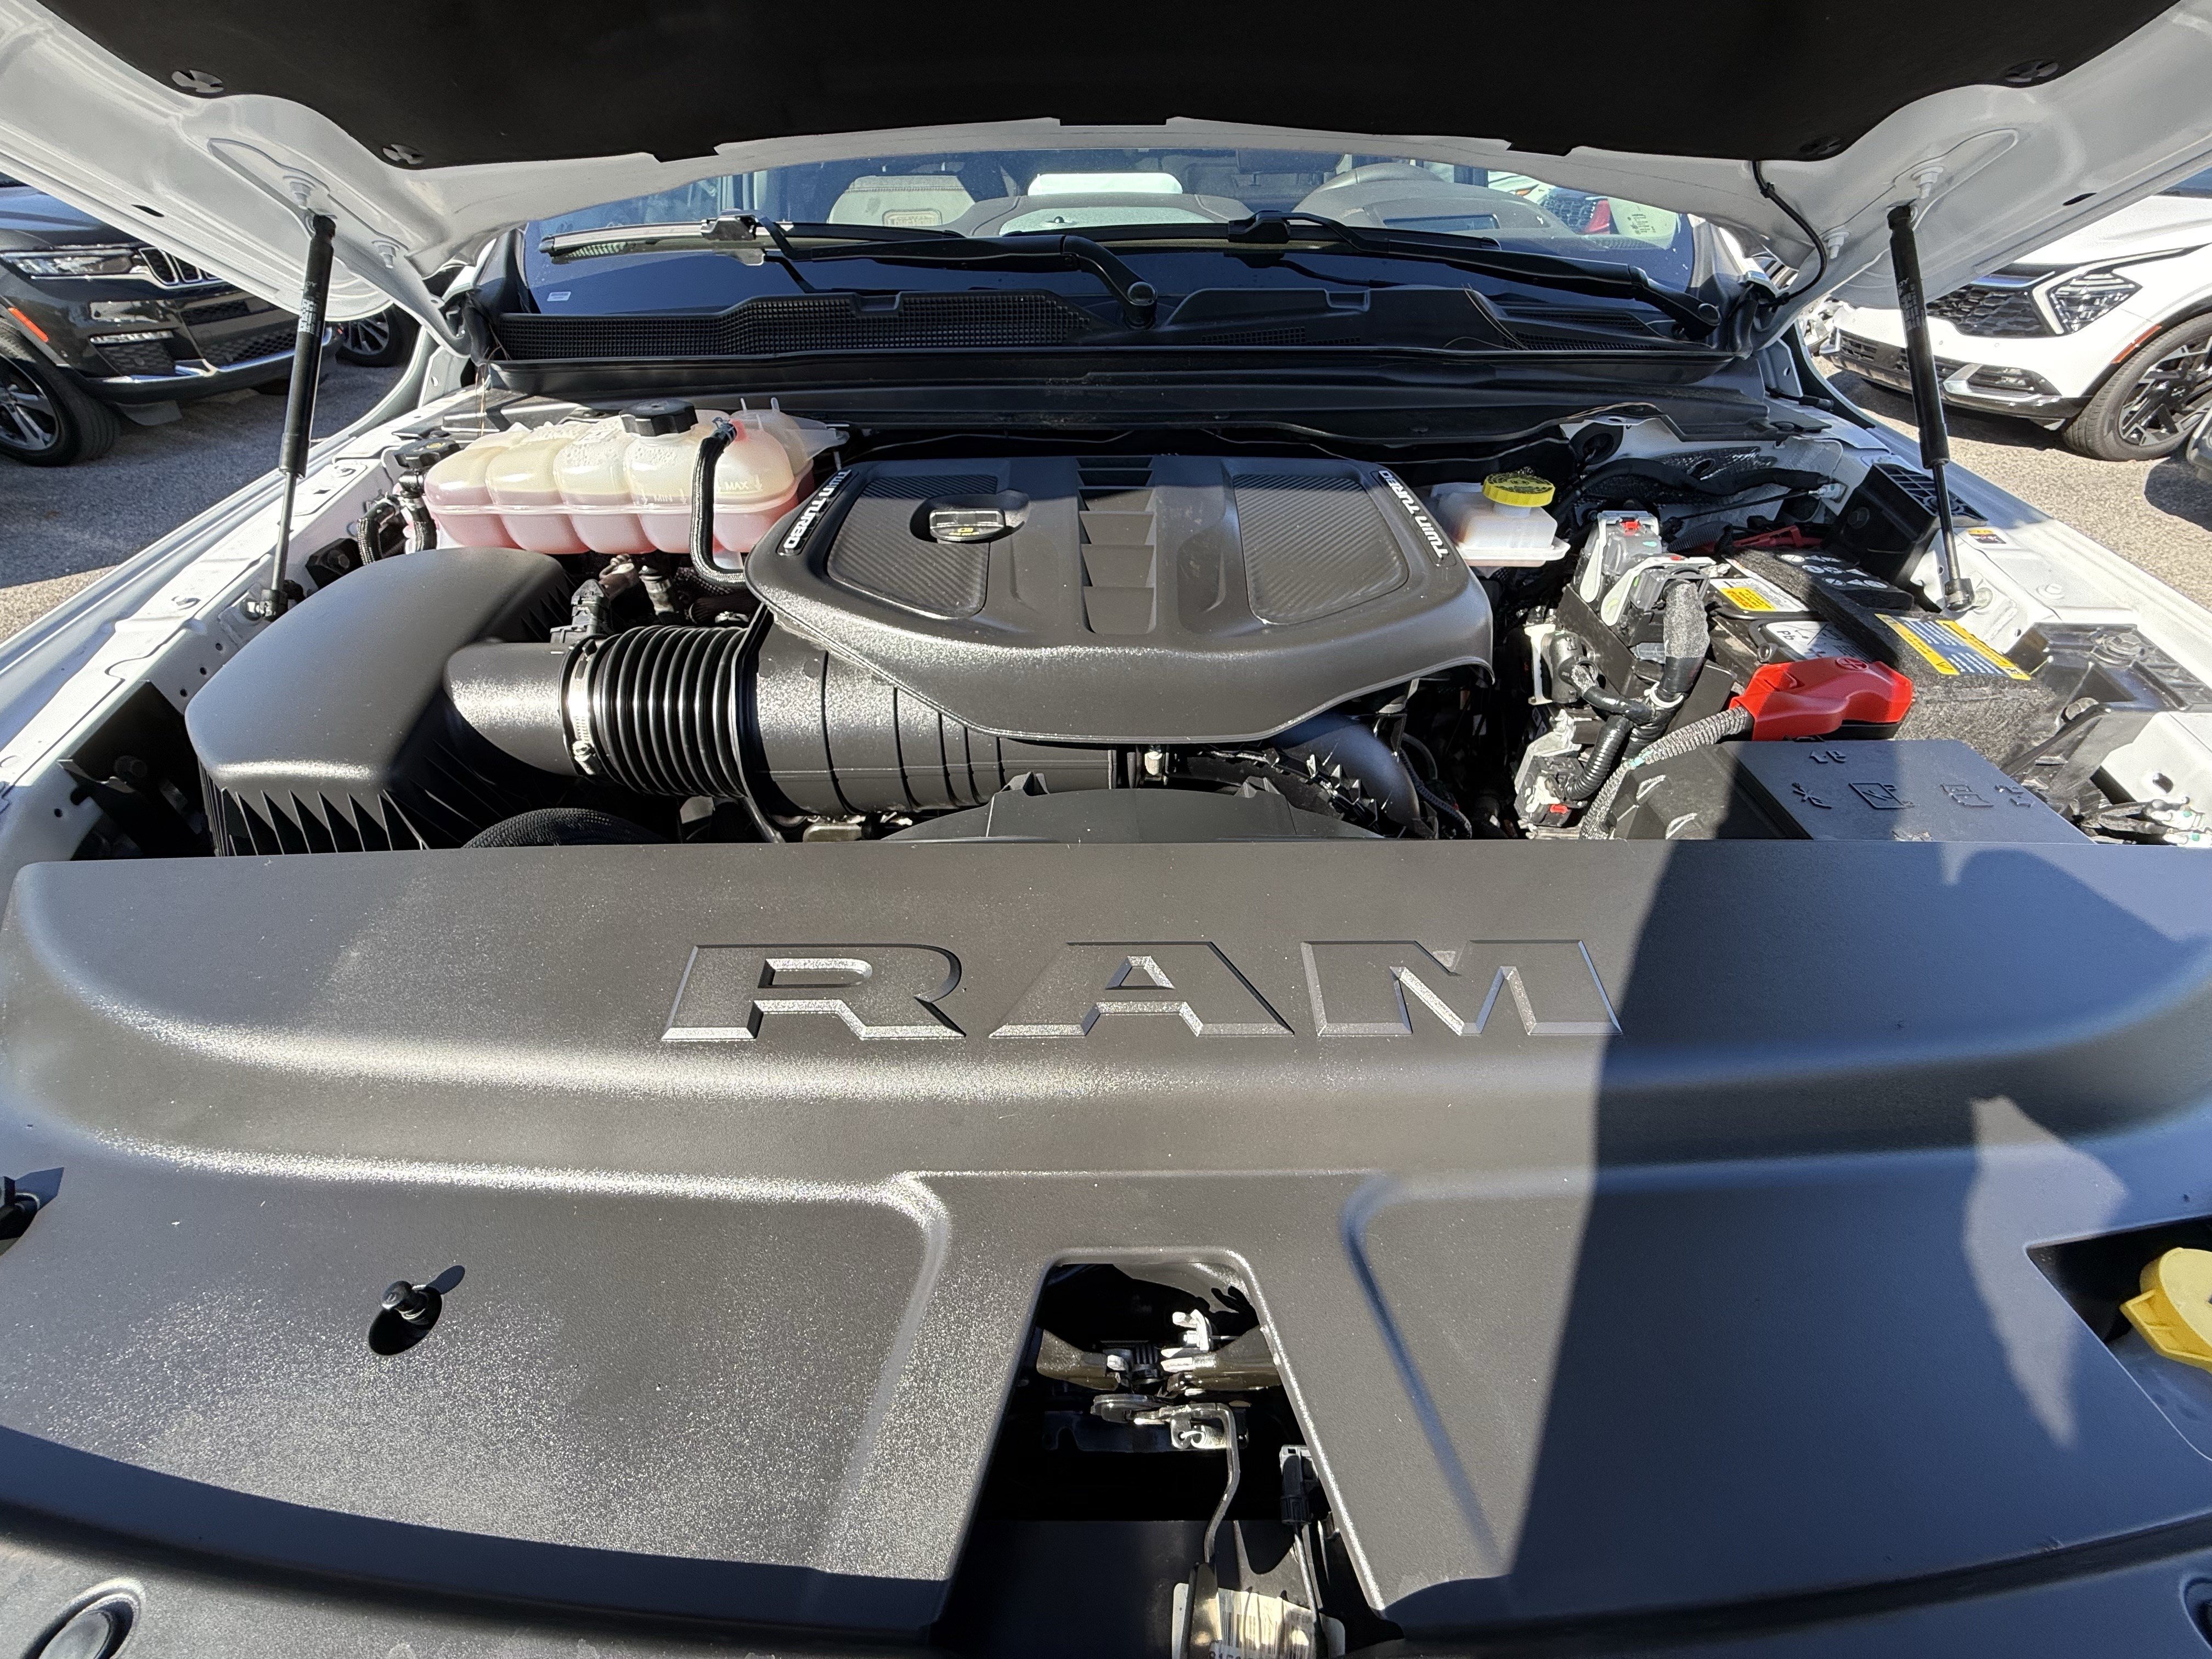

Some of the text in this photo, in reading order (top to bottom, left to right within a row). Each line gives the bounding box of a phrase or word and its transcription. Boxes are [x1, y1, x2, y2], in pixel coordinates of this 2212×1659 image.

[653, 494, 673, 503] MIN
[724, 481, 749, 491] MAX
[783, 470, 851, 549] TWIN TURBO
[1379, 470, 1448, 558] TWIN TURBO
[661, 941, 1624, 1040] RAM
